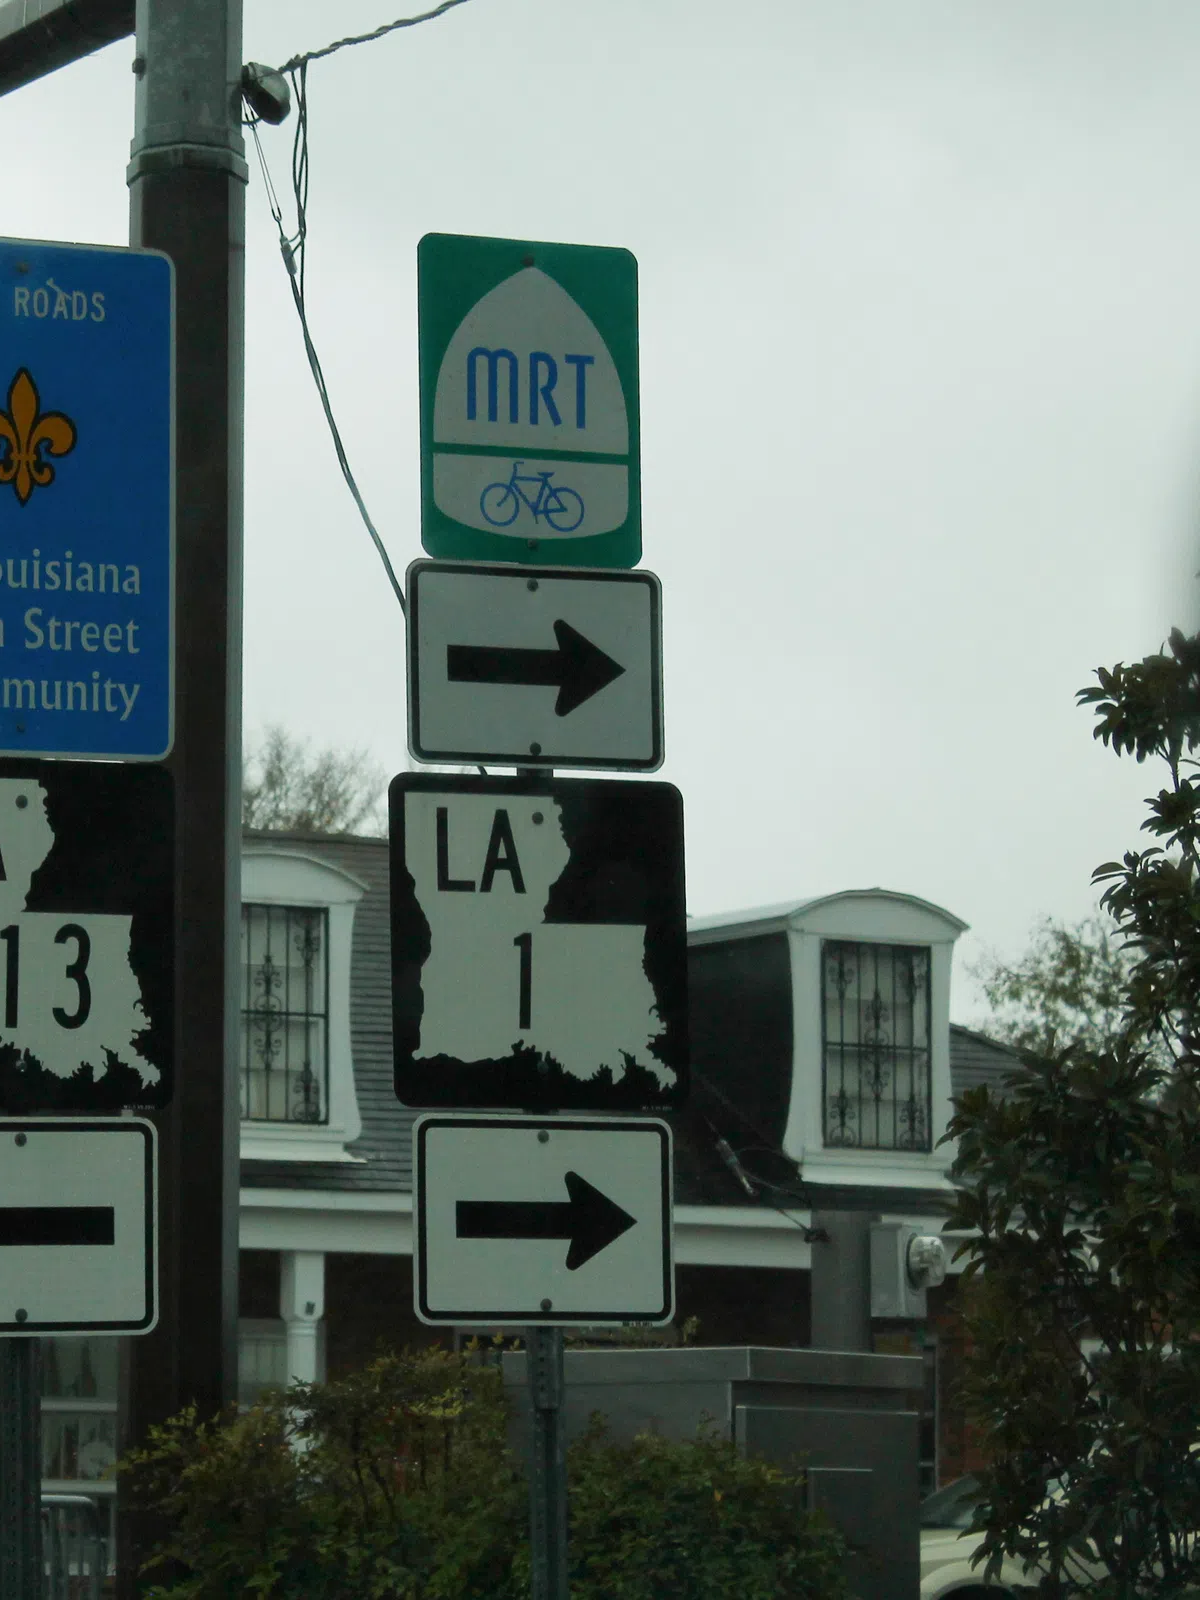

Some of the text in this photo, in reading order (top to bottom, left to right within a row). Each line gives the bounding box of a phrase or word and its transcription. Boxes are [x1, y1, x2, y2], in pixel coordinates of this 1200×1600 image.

[14, 286, 107, 322] ROADS
[466, 346, 596, 430] MRT
[23, 607, 141, 654] Street
[435, 806, 527, 894] LA
[513, 932, 533, 1030] 1
